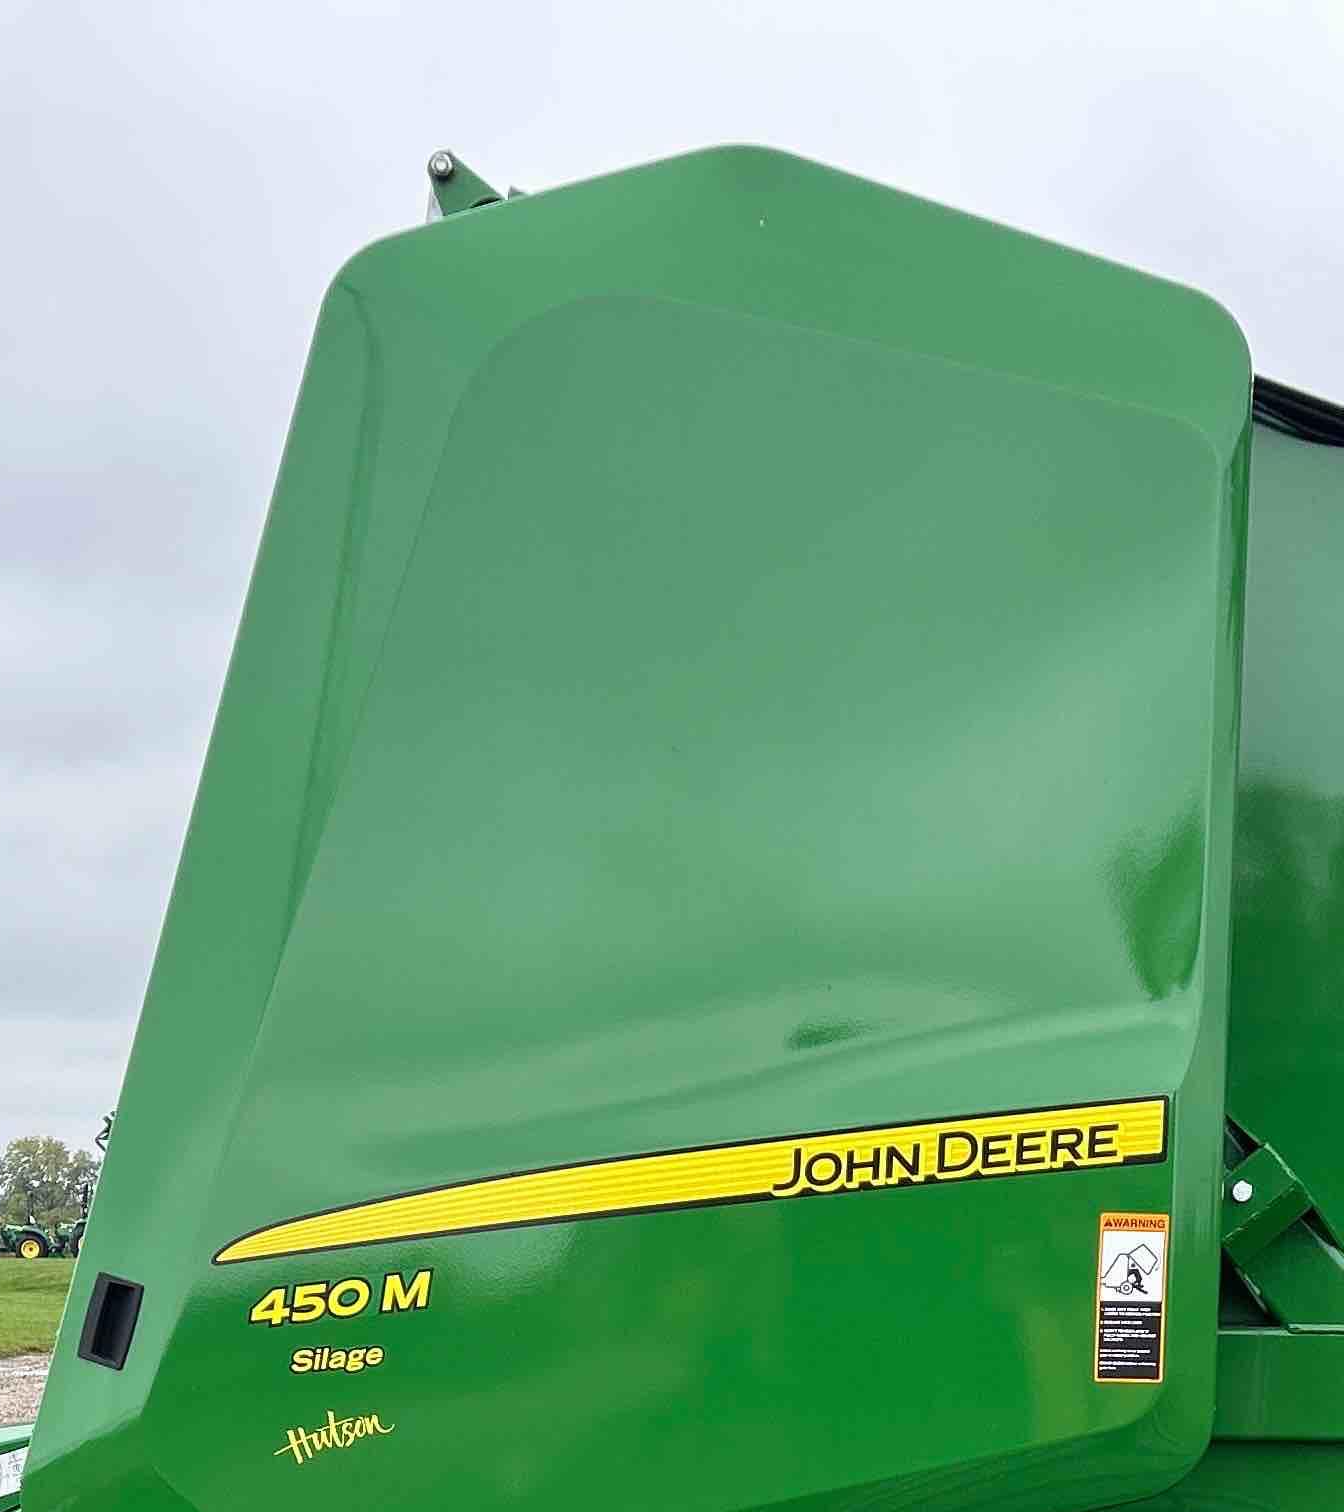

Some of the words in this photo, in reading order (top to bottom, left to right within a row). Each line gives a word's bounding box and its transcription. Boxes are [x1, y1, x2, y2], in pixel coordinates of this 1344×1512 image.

[771, 1142, 920, 1192] JOHN
[936, 1122, 1120, 1174] DEERE
[1113, 1218, 1166, 1229] WARNING
[249, 1277, 372, 1326] 450
[381, 1269, 432, 1312] M
[290, 1346, 385, 1373] Silage
[272, 1409, 396, 1465] Hutson
